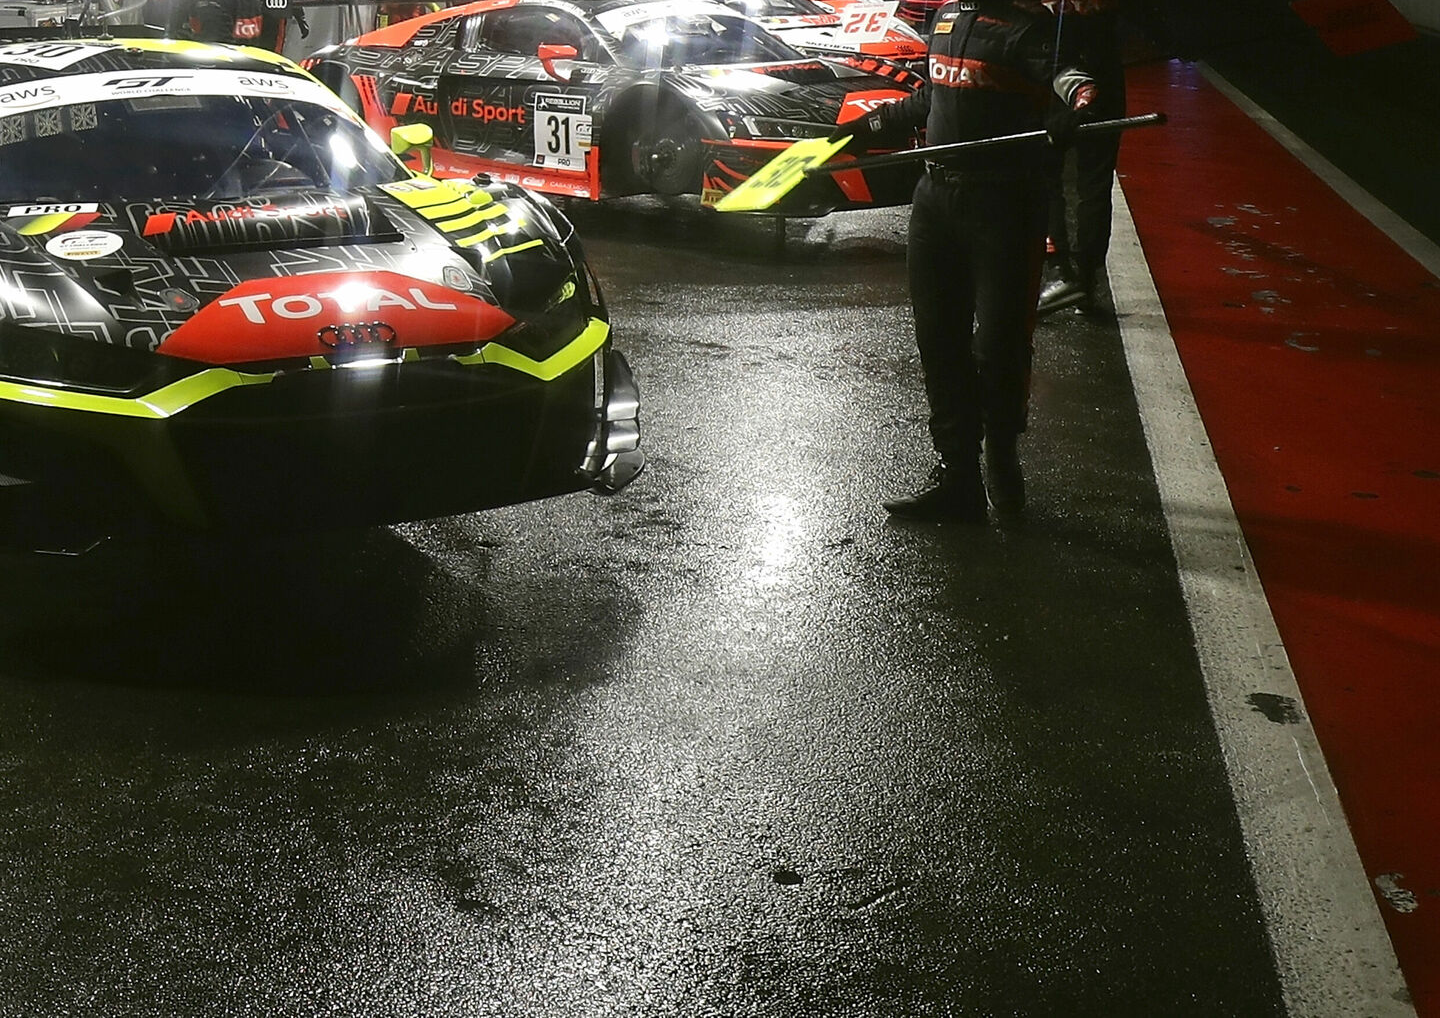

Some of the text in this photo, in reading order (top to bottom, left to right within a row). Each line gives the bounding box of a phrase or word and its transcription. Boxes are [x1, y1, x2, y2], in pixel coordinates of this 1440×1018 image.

[238, 75, 290, 90] aws
[0, 85, 56, 104] aws
[472, 99, 526, 124] Sport
[547, 115, 571, 155] 31
[24, 205, 82, 214] PRO
[184, 203, 347, 224] Audi Sport
[218, 286, 457, 324] TOTAL
